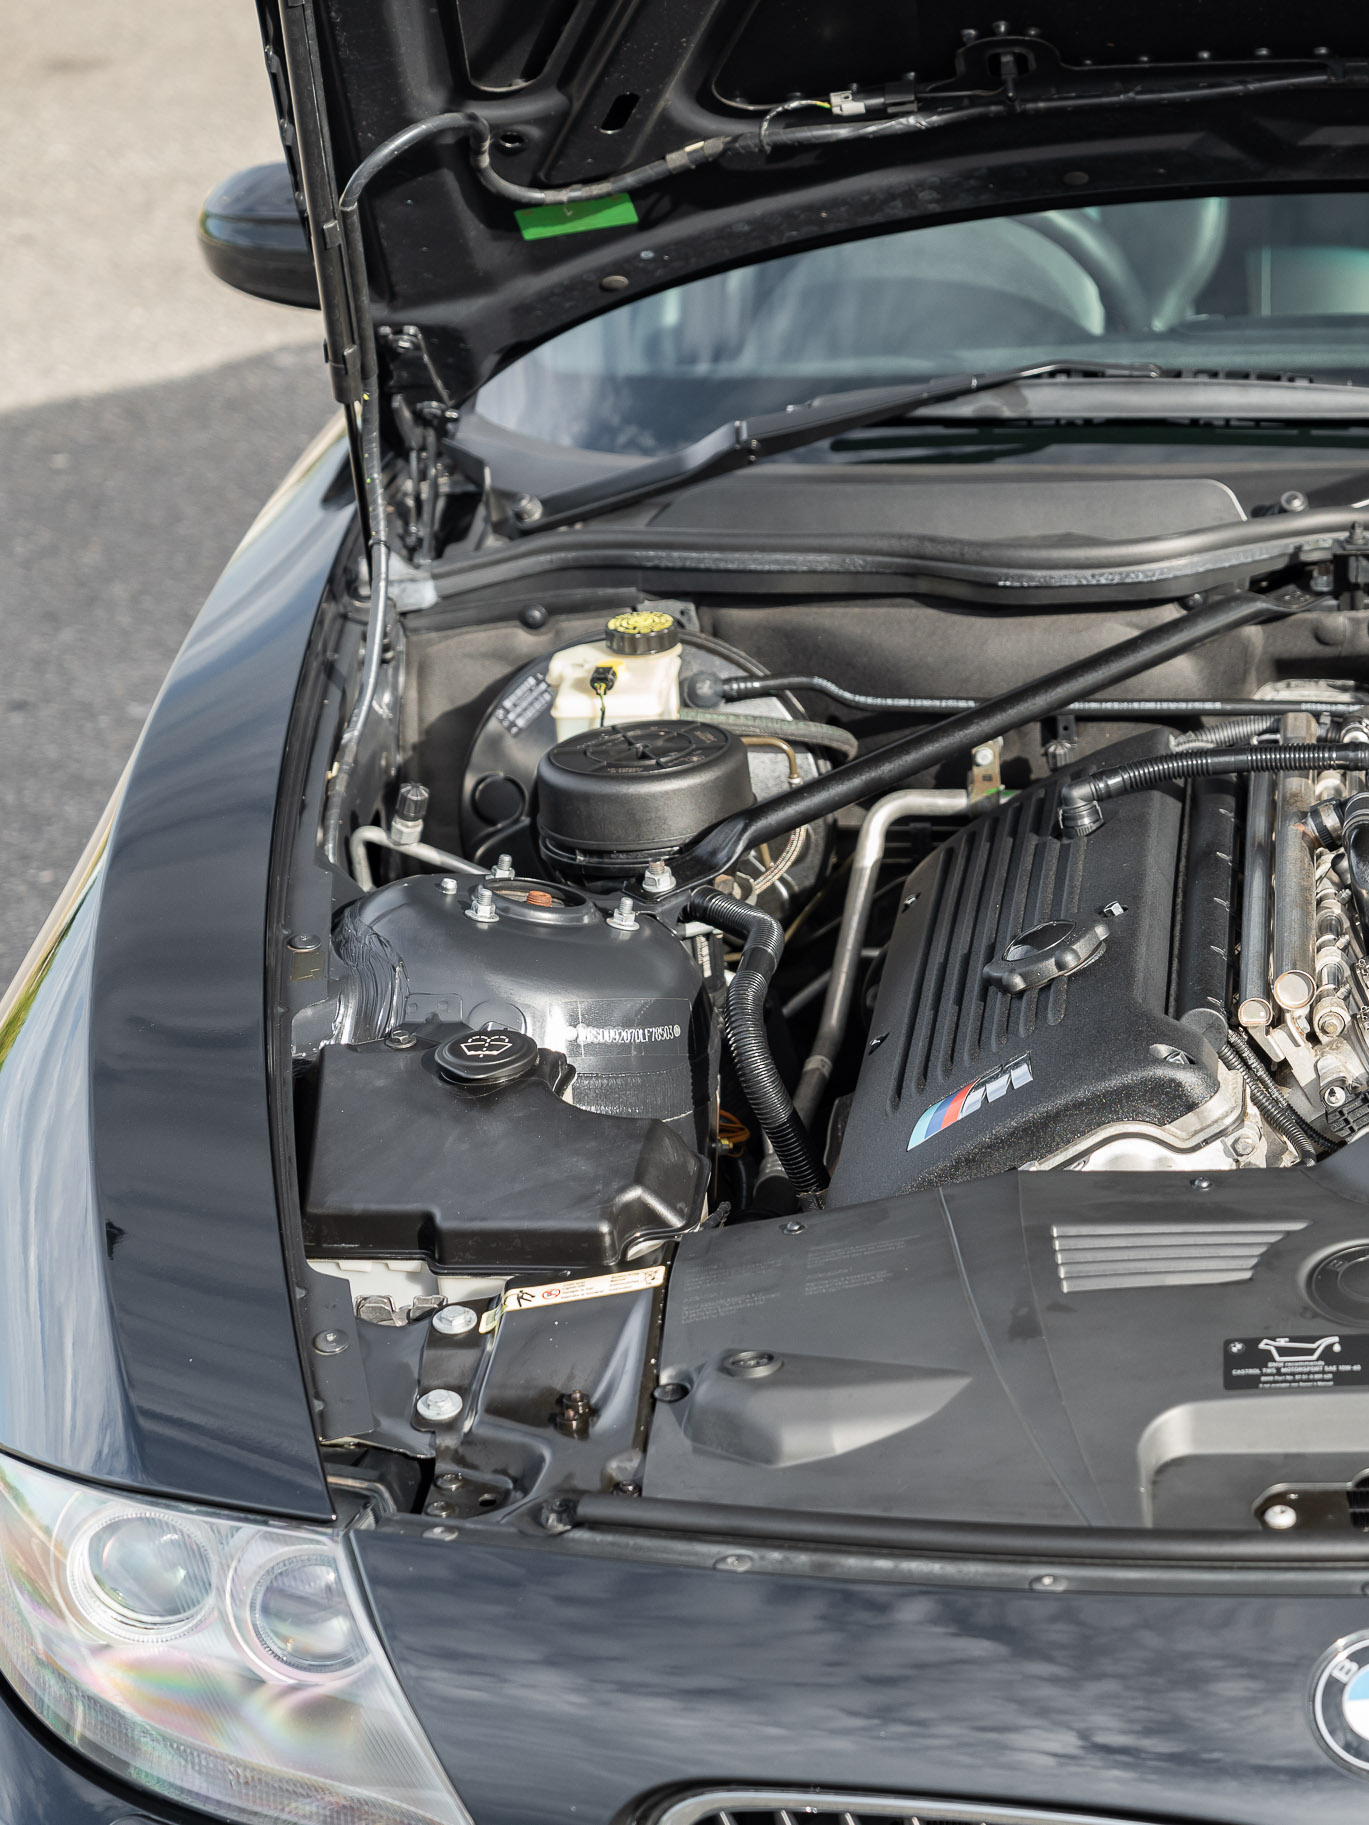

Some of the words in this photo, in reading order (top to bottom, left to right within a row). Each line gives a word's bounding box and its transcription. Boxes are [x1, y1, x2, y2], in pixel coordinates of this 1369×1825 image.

[578, 1025, 674, 1043] BSDU92070LF78503
[1232, 1368, 1261, 1376] CASTROL
[1280, 1365, 1323, 1374] MOTORSPORT
